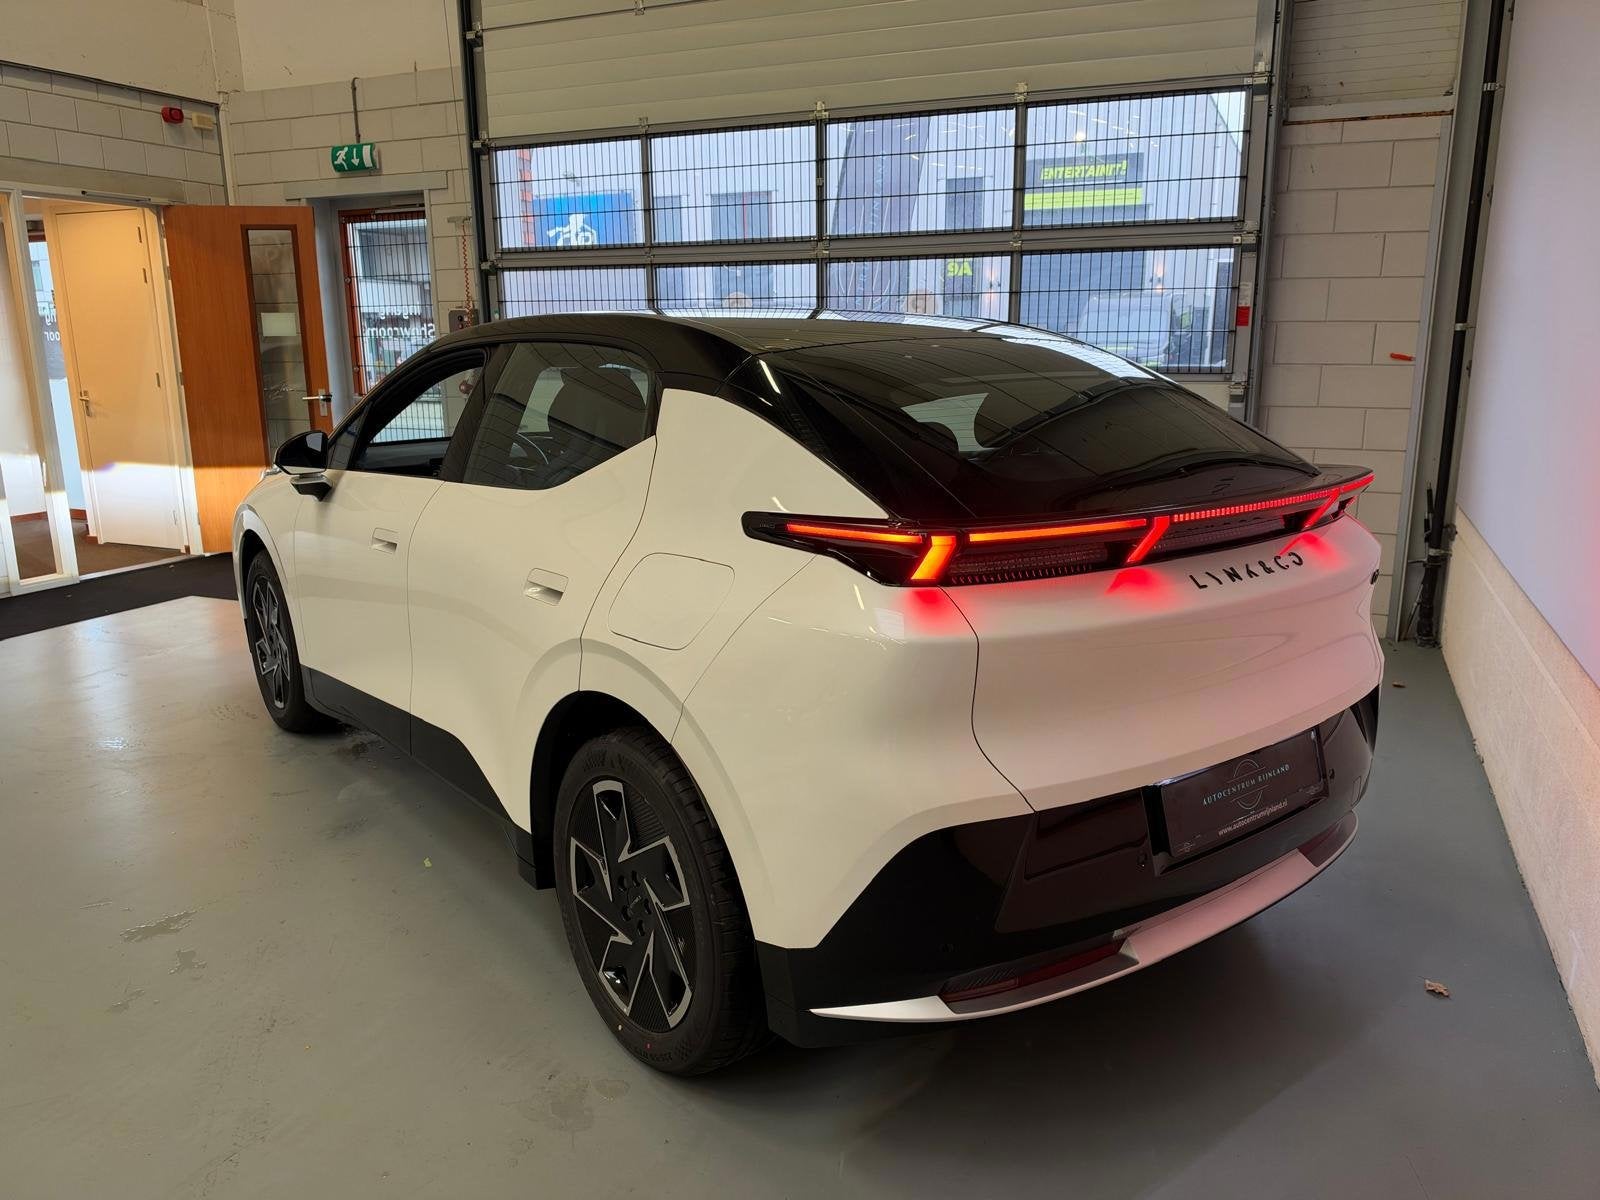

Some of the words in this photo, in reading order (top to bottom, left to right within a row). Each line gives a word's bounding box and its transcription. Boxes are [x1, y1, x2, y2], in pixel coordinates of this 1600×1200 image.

[1203, 778, 1256, 805] AUTOCENTRUM
[1258, 764, 1290, 782] RIJNLAND
[1218, 798, 1289, 835] www.autocentrumrijnland.nl
